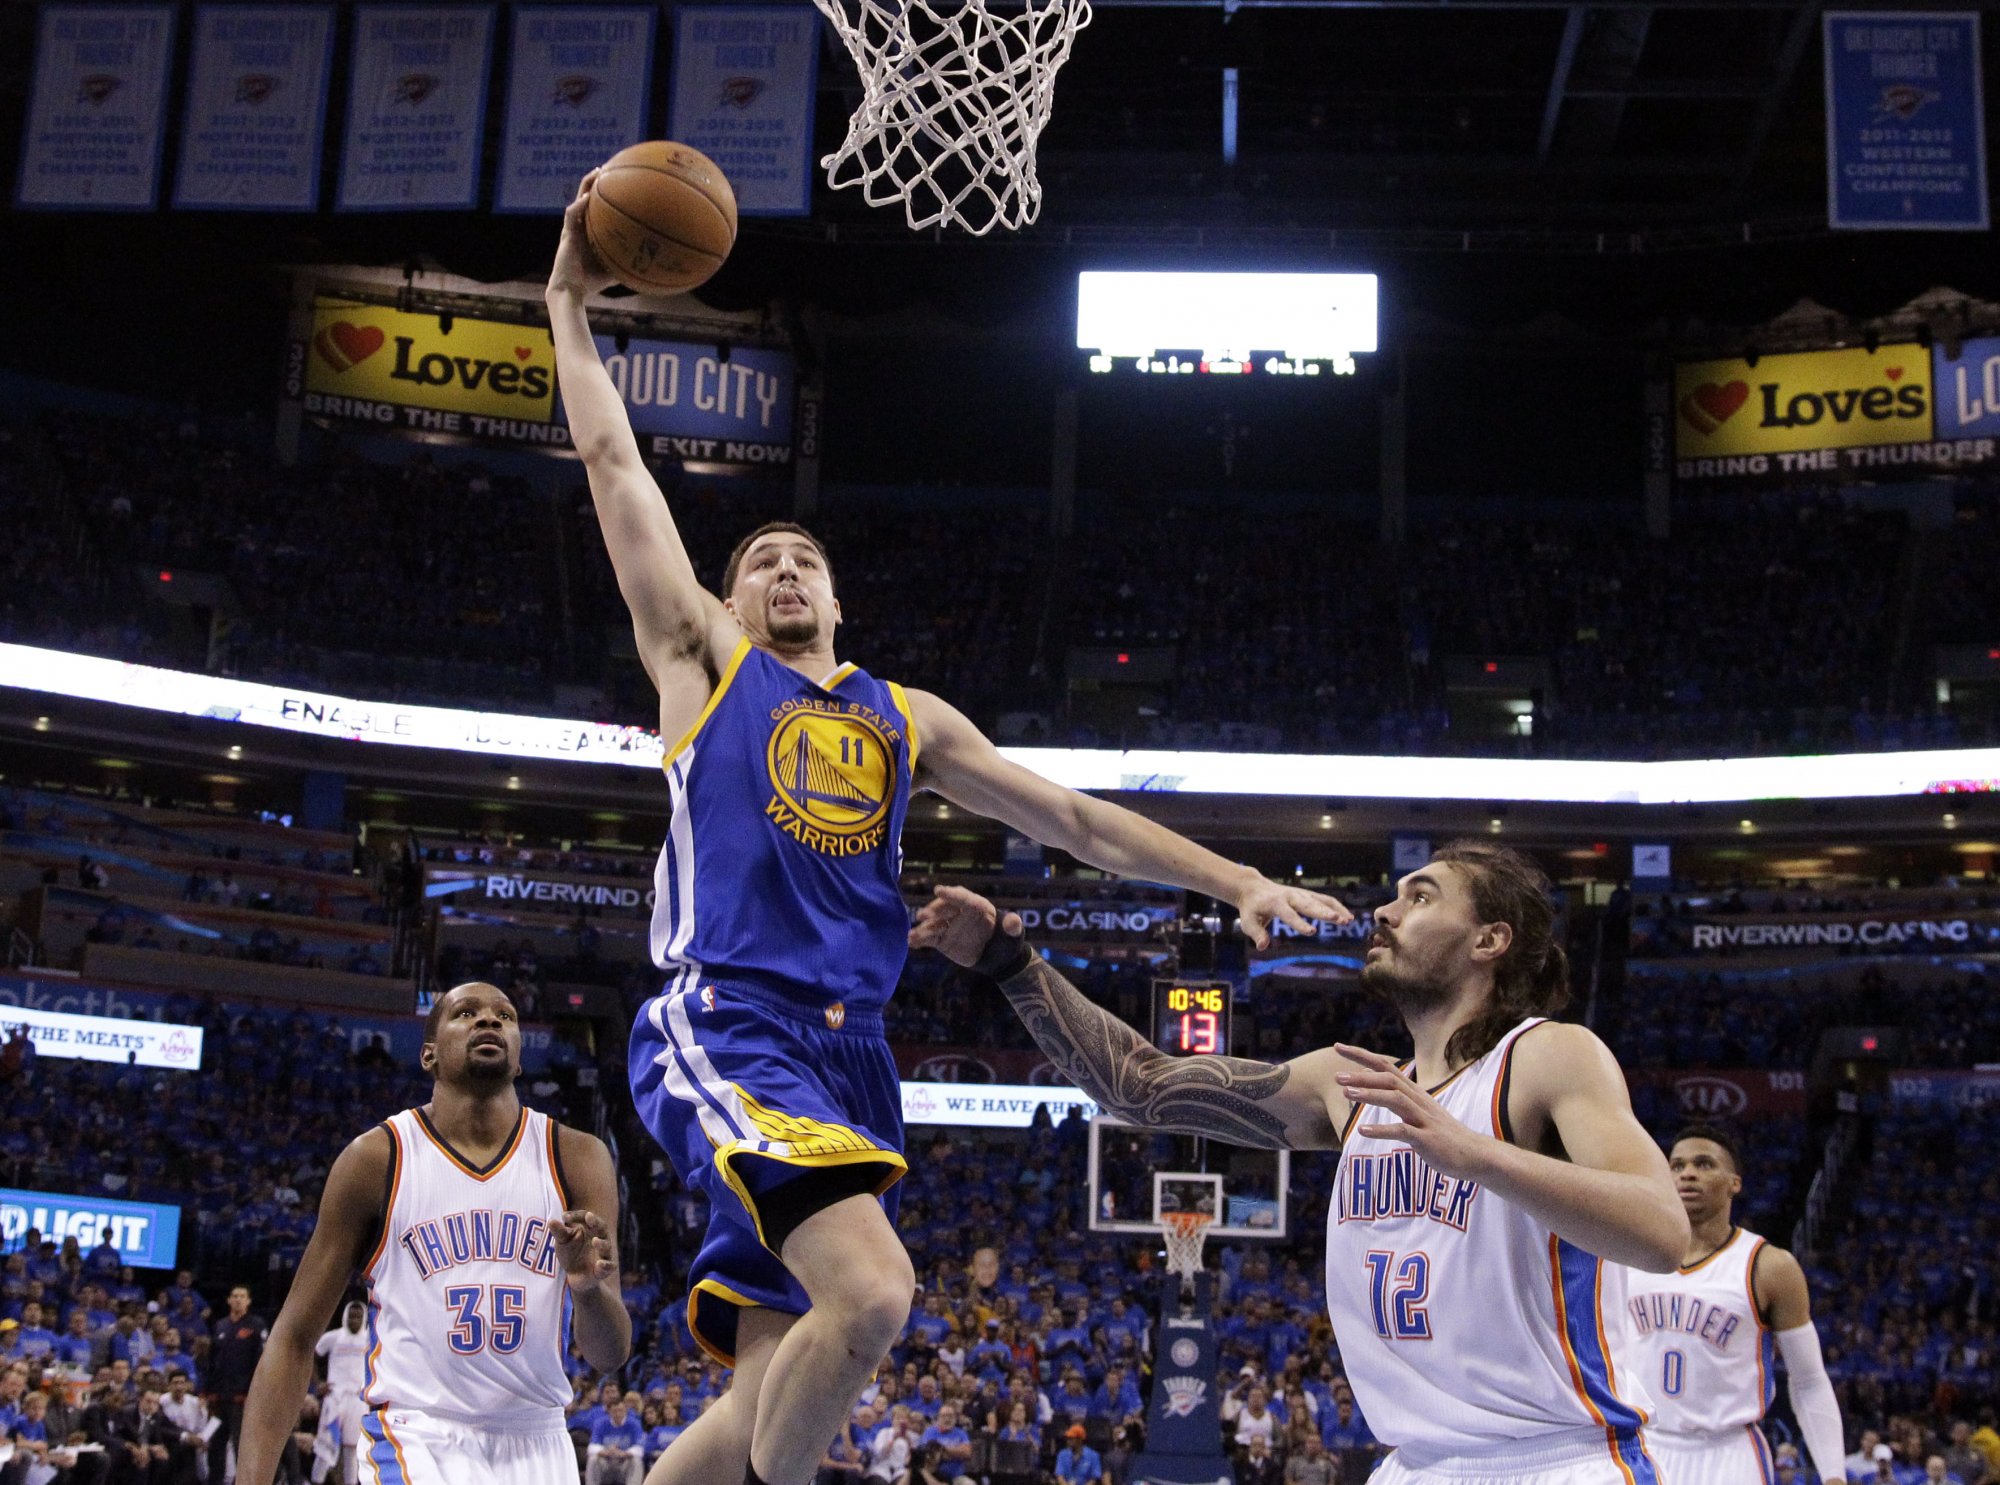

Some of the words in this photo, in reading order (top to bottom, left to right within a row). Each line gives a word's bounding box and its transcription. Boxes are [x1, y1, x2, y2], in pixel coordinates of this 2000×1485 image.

[610, 352, 680, 407] OUD
[693, 357, 778, 428] CITY
[305, 394, 395, 423] BRING
[403, 407, 463, 432] THE
[470, 418, 572, 445] THUND
[652, 436, 719, 459] EXIT
[725, 441, 791, 464] NOW
[1676, 454, 1768, 479] BRING
[1776, 449, 1838, 472] THE
[1845, 439, 1995, 465] THUNDER
[770, 698, 840, 721] GOLDEN
[848, 703, 901, 743] STATE
[839, 736, 864, 767] 11
[765, 795, 887, 857] WARRIORS
[485, 876, 640, 907] RIVERWIND
[1046, 909, 1150, 932] CASINO
[1693, 923, 1852, 948] RIVERWIND
[1168, 988, 1223, 1012] 10:46
[31, 1025, 69, 1042] THE
[75, 1030, 145, 1049] MEATS
[1180, 1013, 1217, 1054] 13
[1767, 1072, 1805, 1090] 101
[946, 1097, 976, 1112] WE
[982, 1099, 1033, 1114] HAVE
[33, 1207, 149, 1252] LIGHT
[1364, 1250, 1434, 1341] 12
[445, 1284, 527, 1356] 35
[1628, 1292, 1743, 1351] HUNDER
[1661, 1349, 1687, 1399] 0
